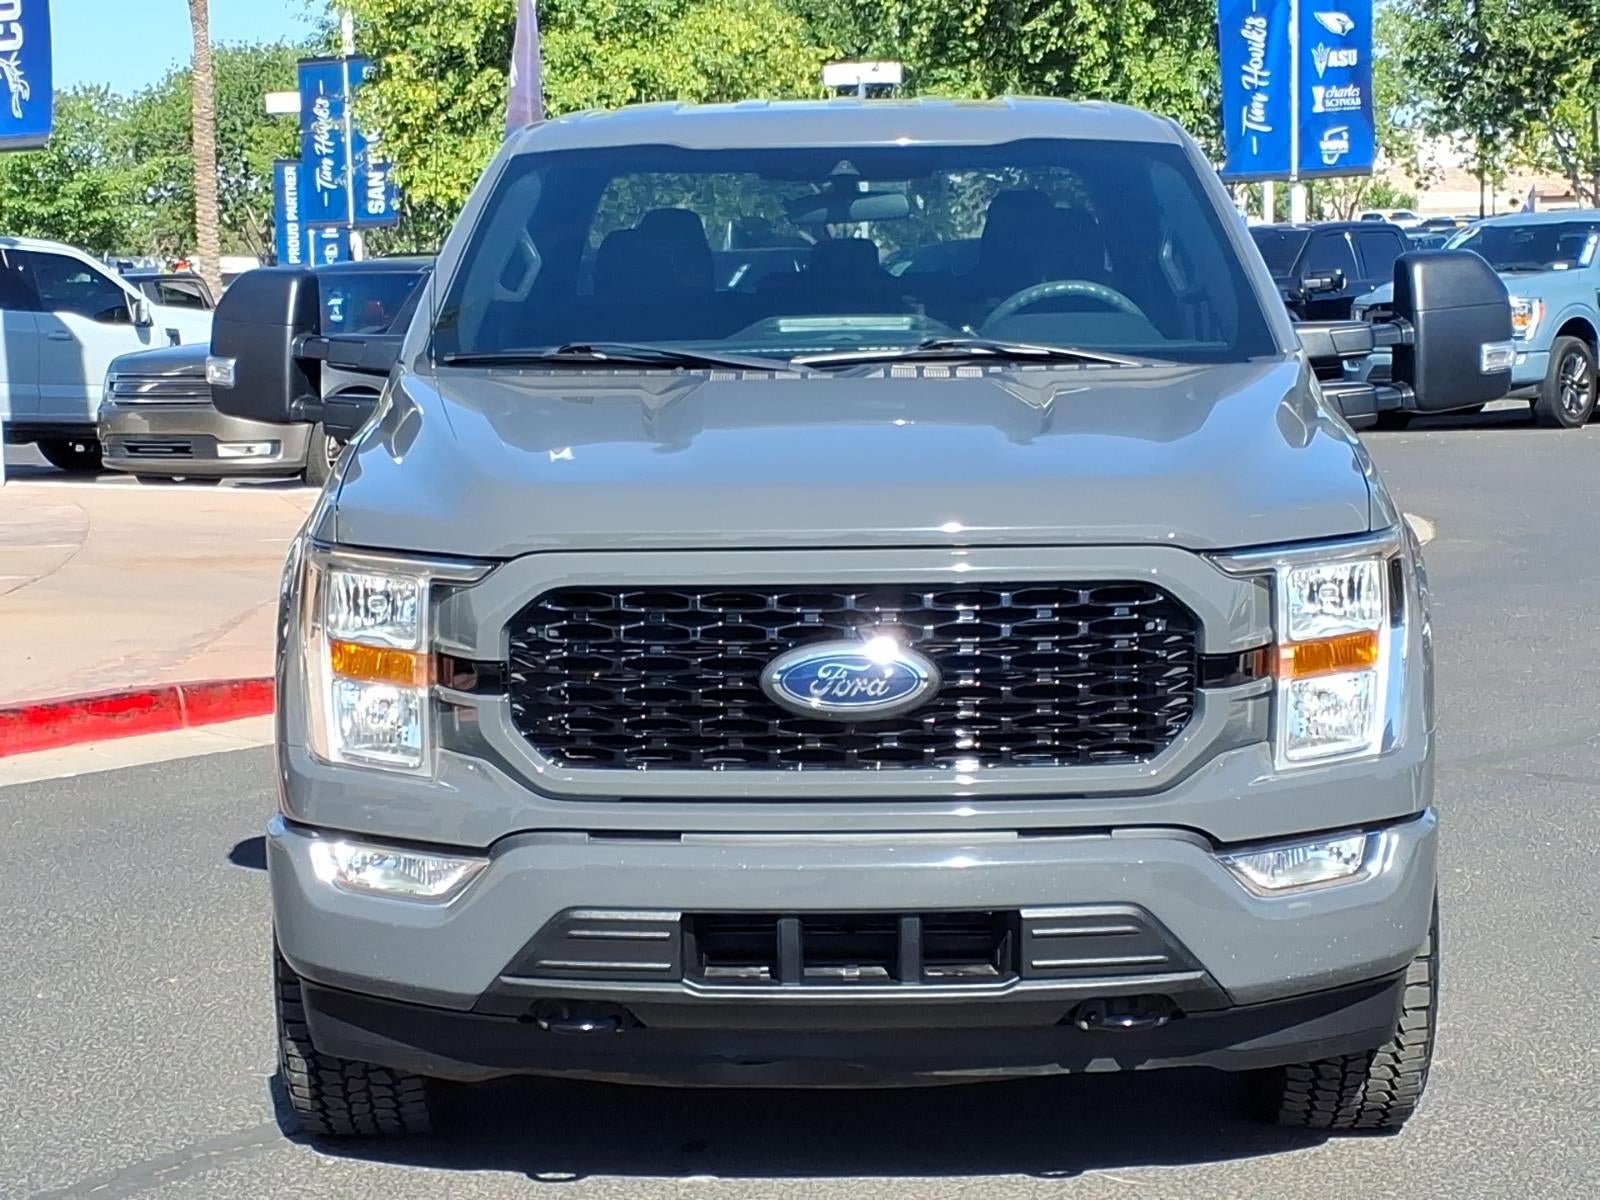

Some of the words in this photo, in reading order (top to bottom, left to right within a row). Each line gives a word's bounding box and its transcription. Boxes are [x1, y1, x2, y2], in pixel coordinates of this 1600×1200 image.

[1328, 48, 1358, 68] ASU
[1242, 92, 1273, 137] Tim
[284, 166, 299, 221] PARTNER
[367, 171, 386, 215] SAN
[287, 223, 302, 264] PROUD
[810, 663, 893, 697] Ford
